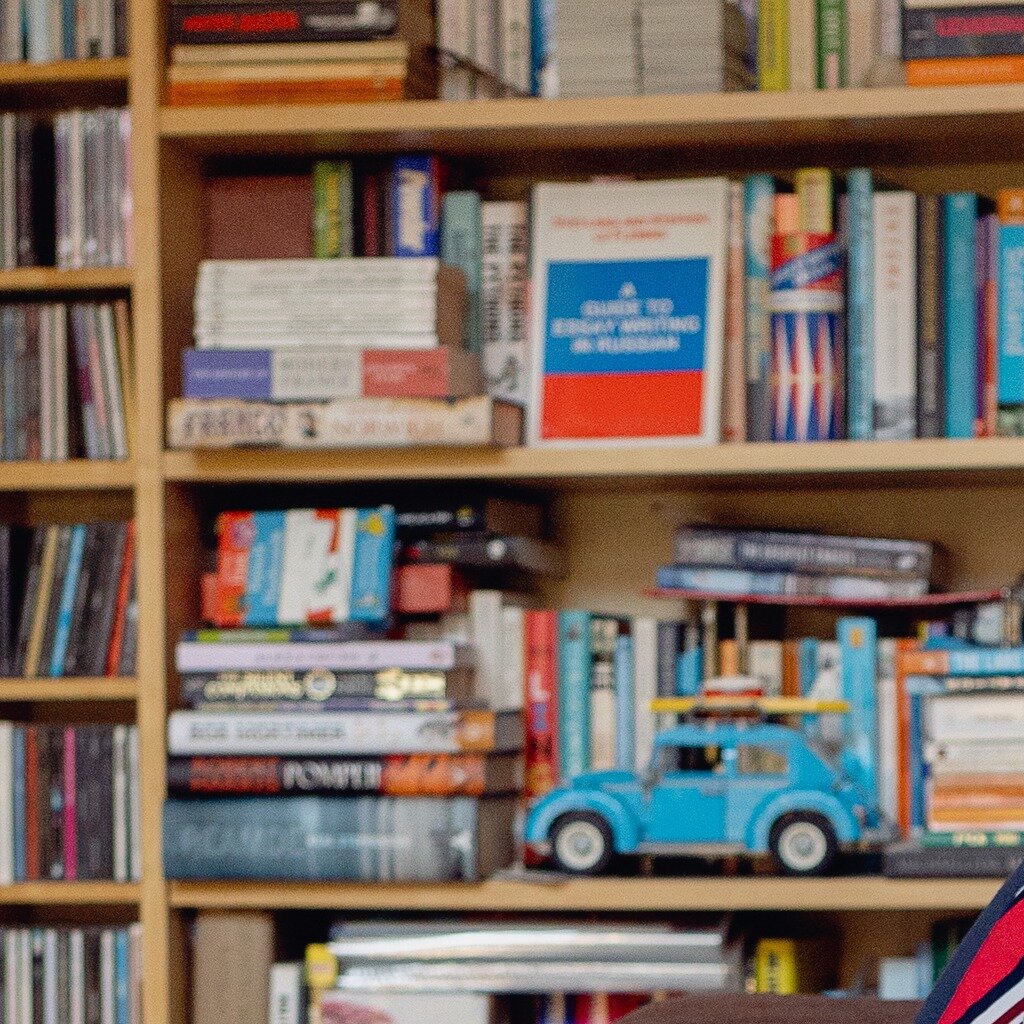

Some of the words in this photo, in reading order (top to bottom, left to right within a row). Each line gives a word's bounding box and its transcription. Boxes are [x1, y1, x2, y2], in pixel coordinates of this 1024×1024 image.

[581, 299, 640, 316] GUIDE
[646, 298, 674, 315] TO
[552, 318, 615, 337] ESSAY
[620, 315, 700, 334] WRITING
[597, 336, 680, 353] RUSSIAN
